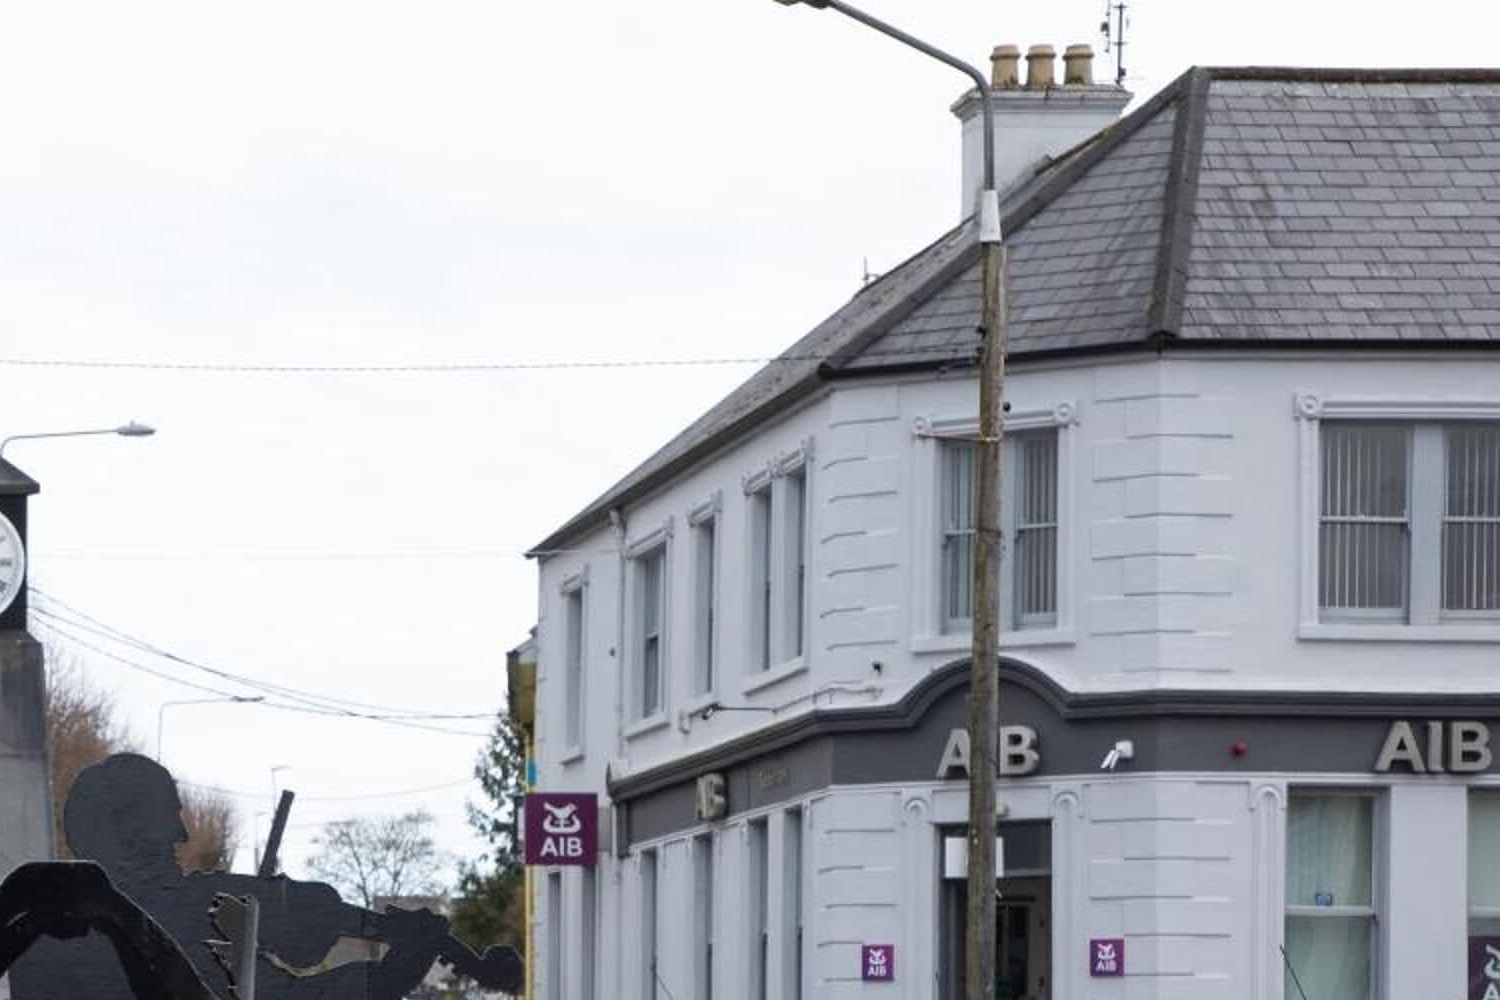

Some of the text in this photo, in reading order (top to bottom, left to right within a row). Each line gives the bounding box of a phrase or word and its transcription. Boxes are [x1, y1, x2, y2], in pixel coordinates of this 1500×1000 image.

[935, 725, 1040, 778] AB
[1374, 719, 1492, 772] AIB
[539, 836, 584, 857] AIB
